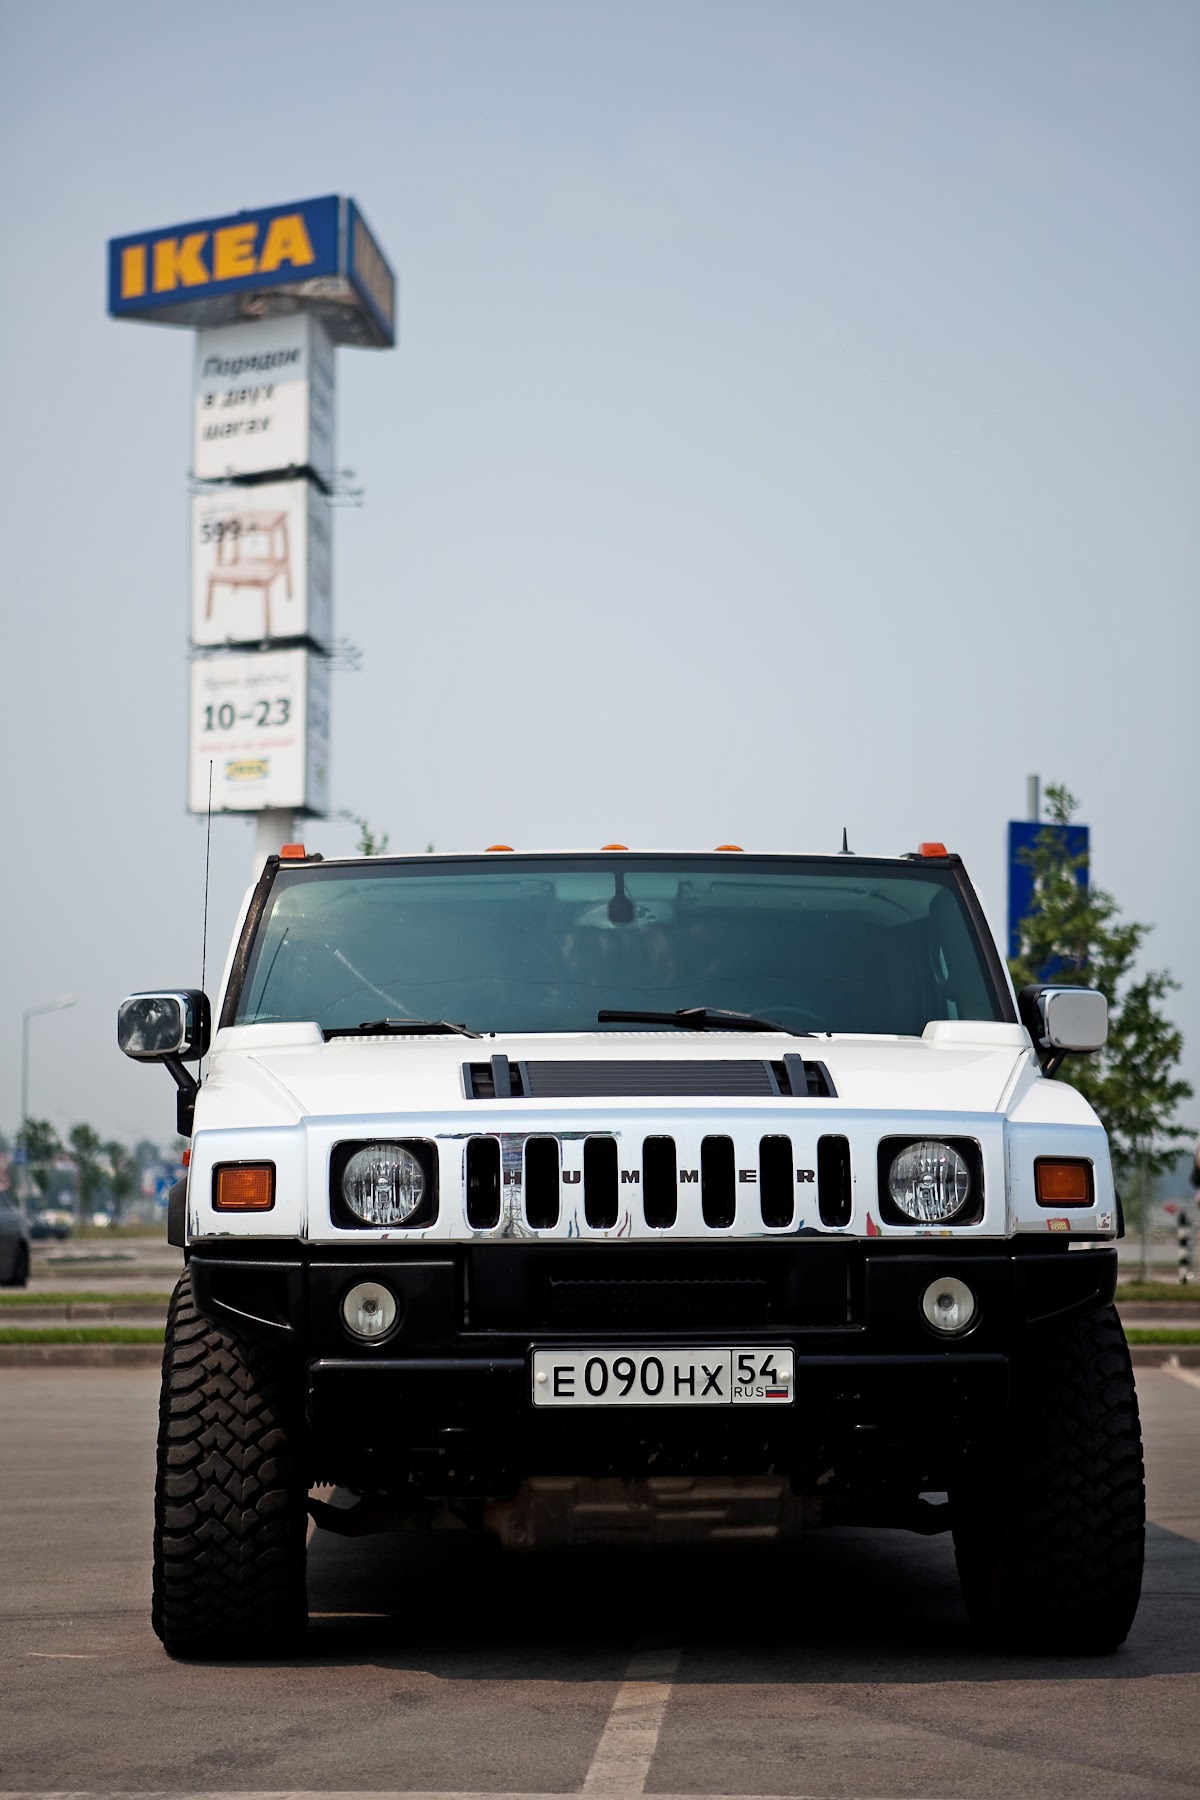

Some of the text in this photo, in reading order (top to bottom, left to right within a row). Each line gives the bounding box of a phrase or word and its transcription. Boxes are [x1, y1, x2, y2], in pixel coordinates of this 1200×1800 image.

[121, 214, 315, 299] IKEA
[503, 1169, 815, 1185] HUMMER
[737, 1354, 777, 1384] 54
[734, 1387, 764, 1397] RUS
